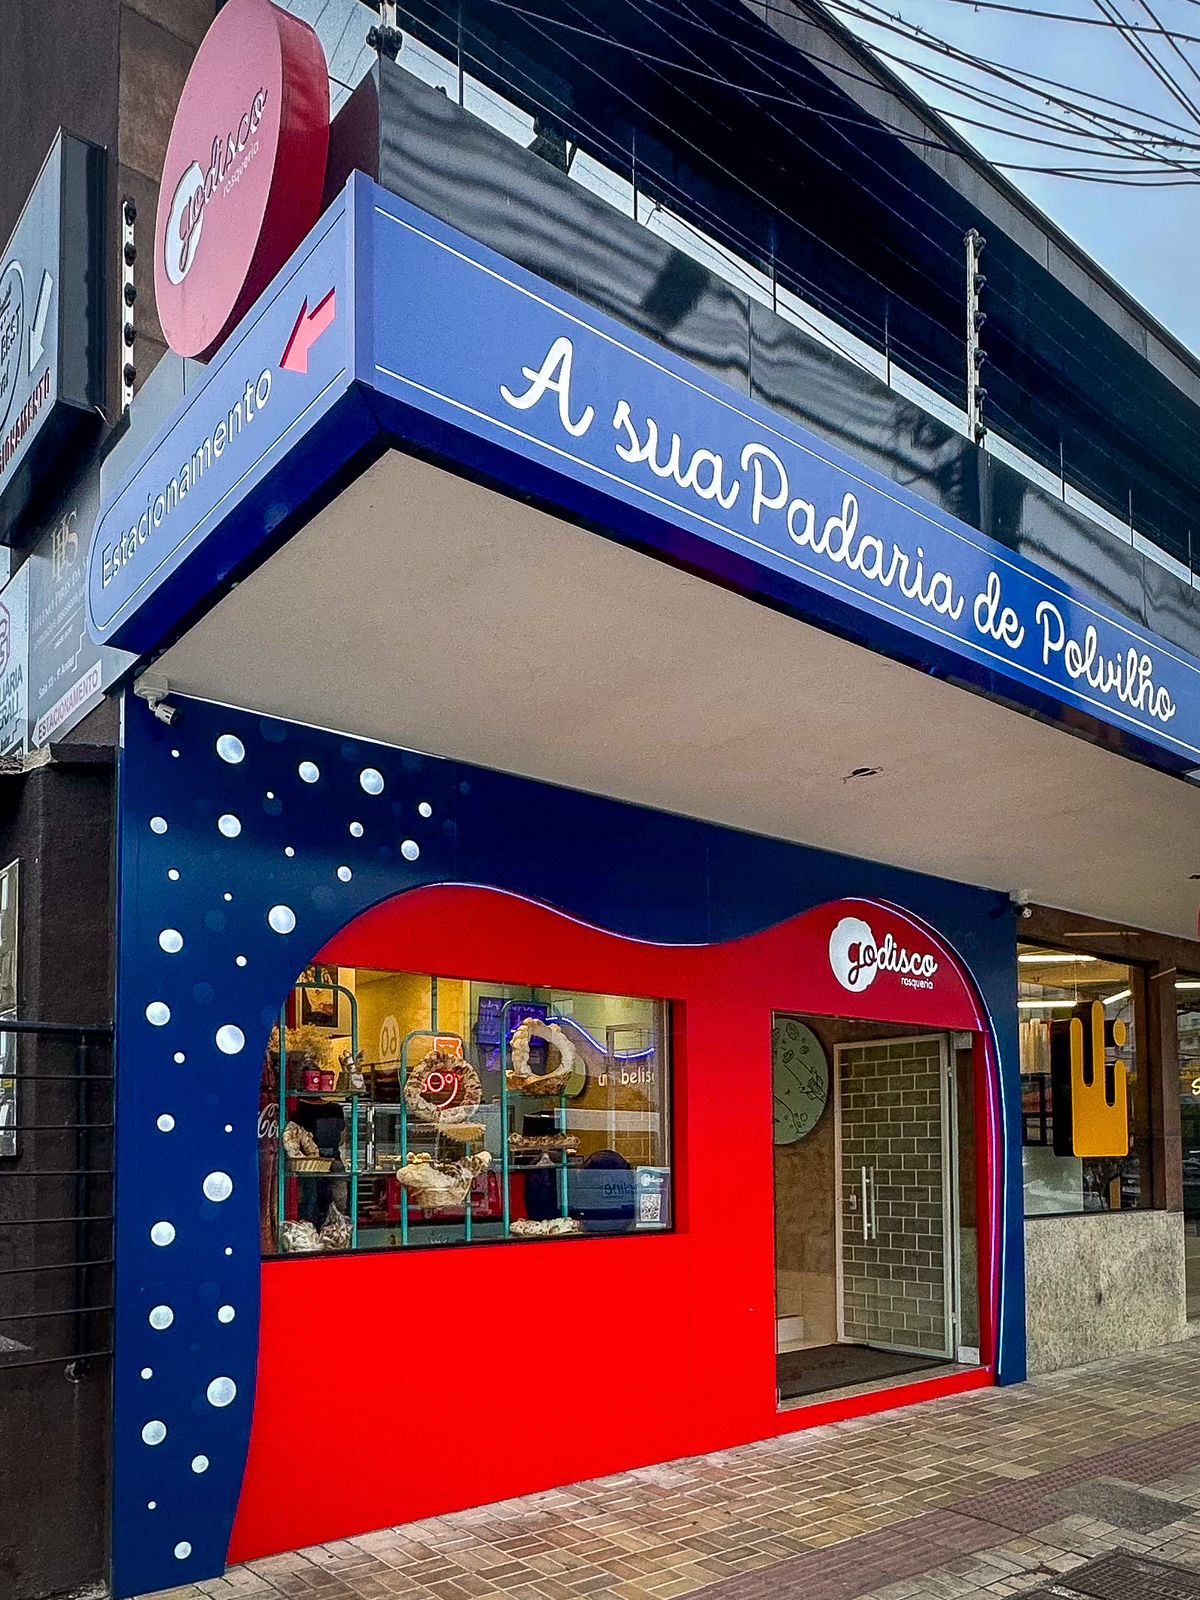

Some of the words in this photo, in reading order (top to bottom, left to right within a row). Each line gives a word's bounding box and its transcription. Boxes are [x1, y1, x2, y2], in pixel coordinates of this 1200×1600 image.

[178, 86, 269, 274] godisco
[223, 140, 260, 198] rosqueria
[101, 367, 273, 590] Estacionamento
[499, 335, 595, 437] A
[612, 399, 740, 510] sua
[740, 441, 965, 621] Padaria
[973, 571, 1025, 649] de
[1035, 600, 1176, 722] Polvilho
[38, 669, 99, 741] ESTACIONAMENTO
[847, 933, 938, 985] godisco
[900, 976, 934, 990] rosqueria
